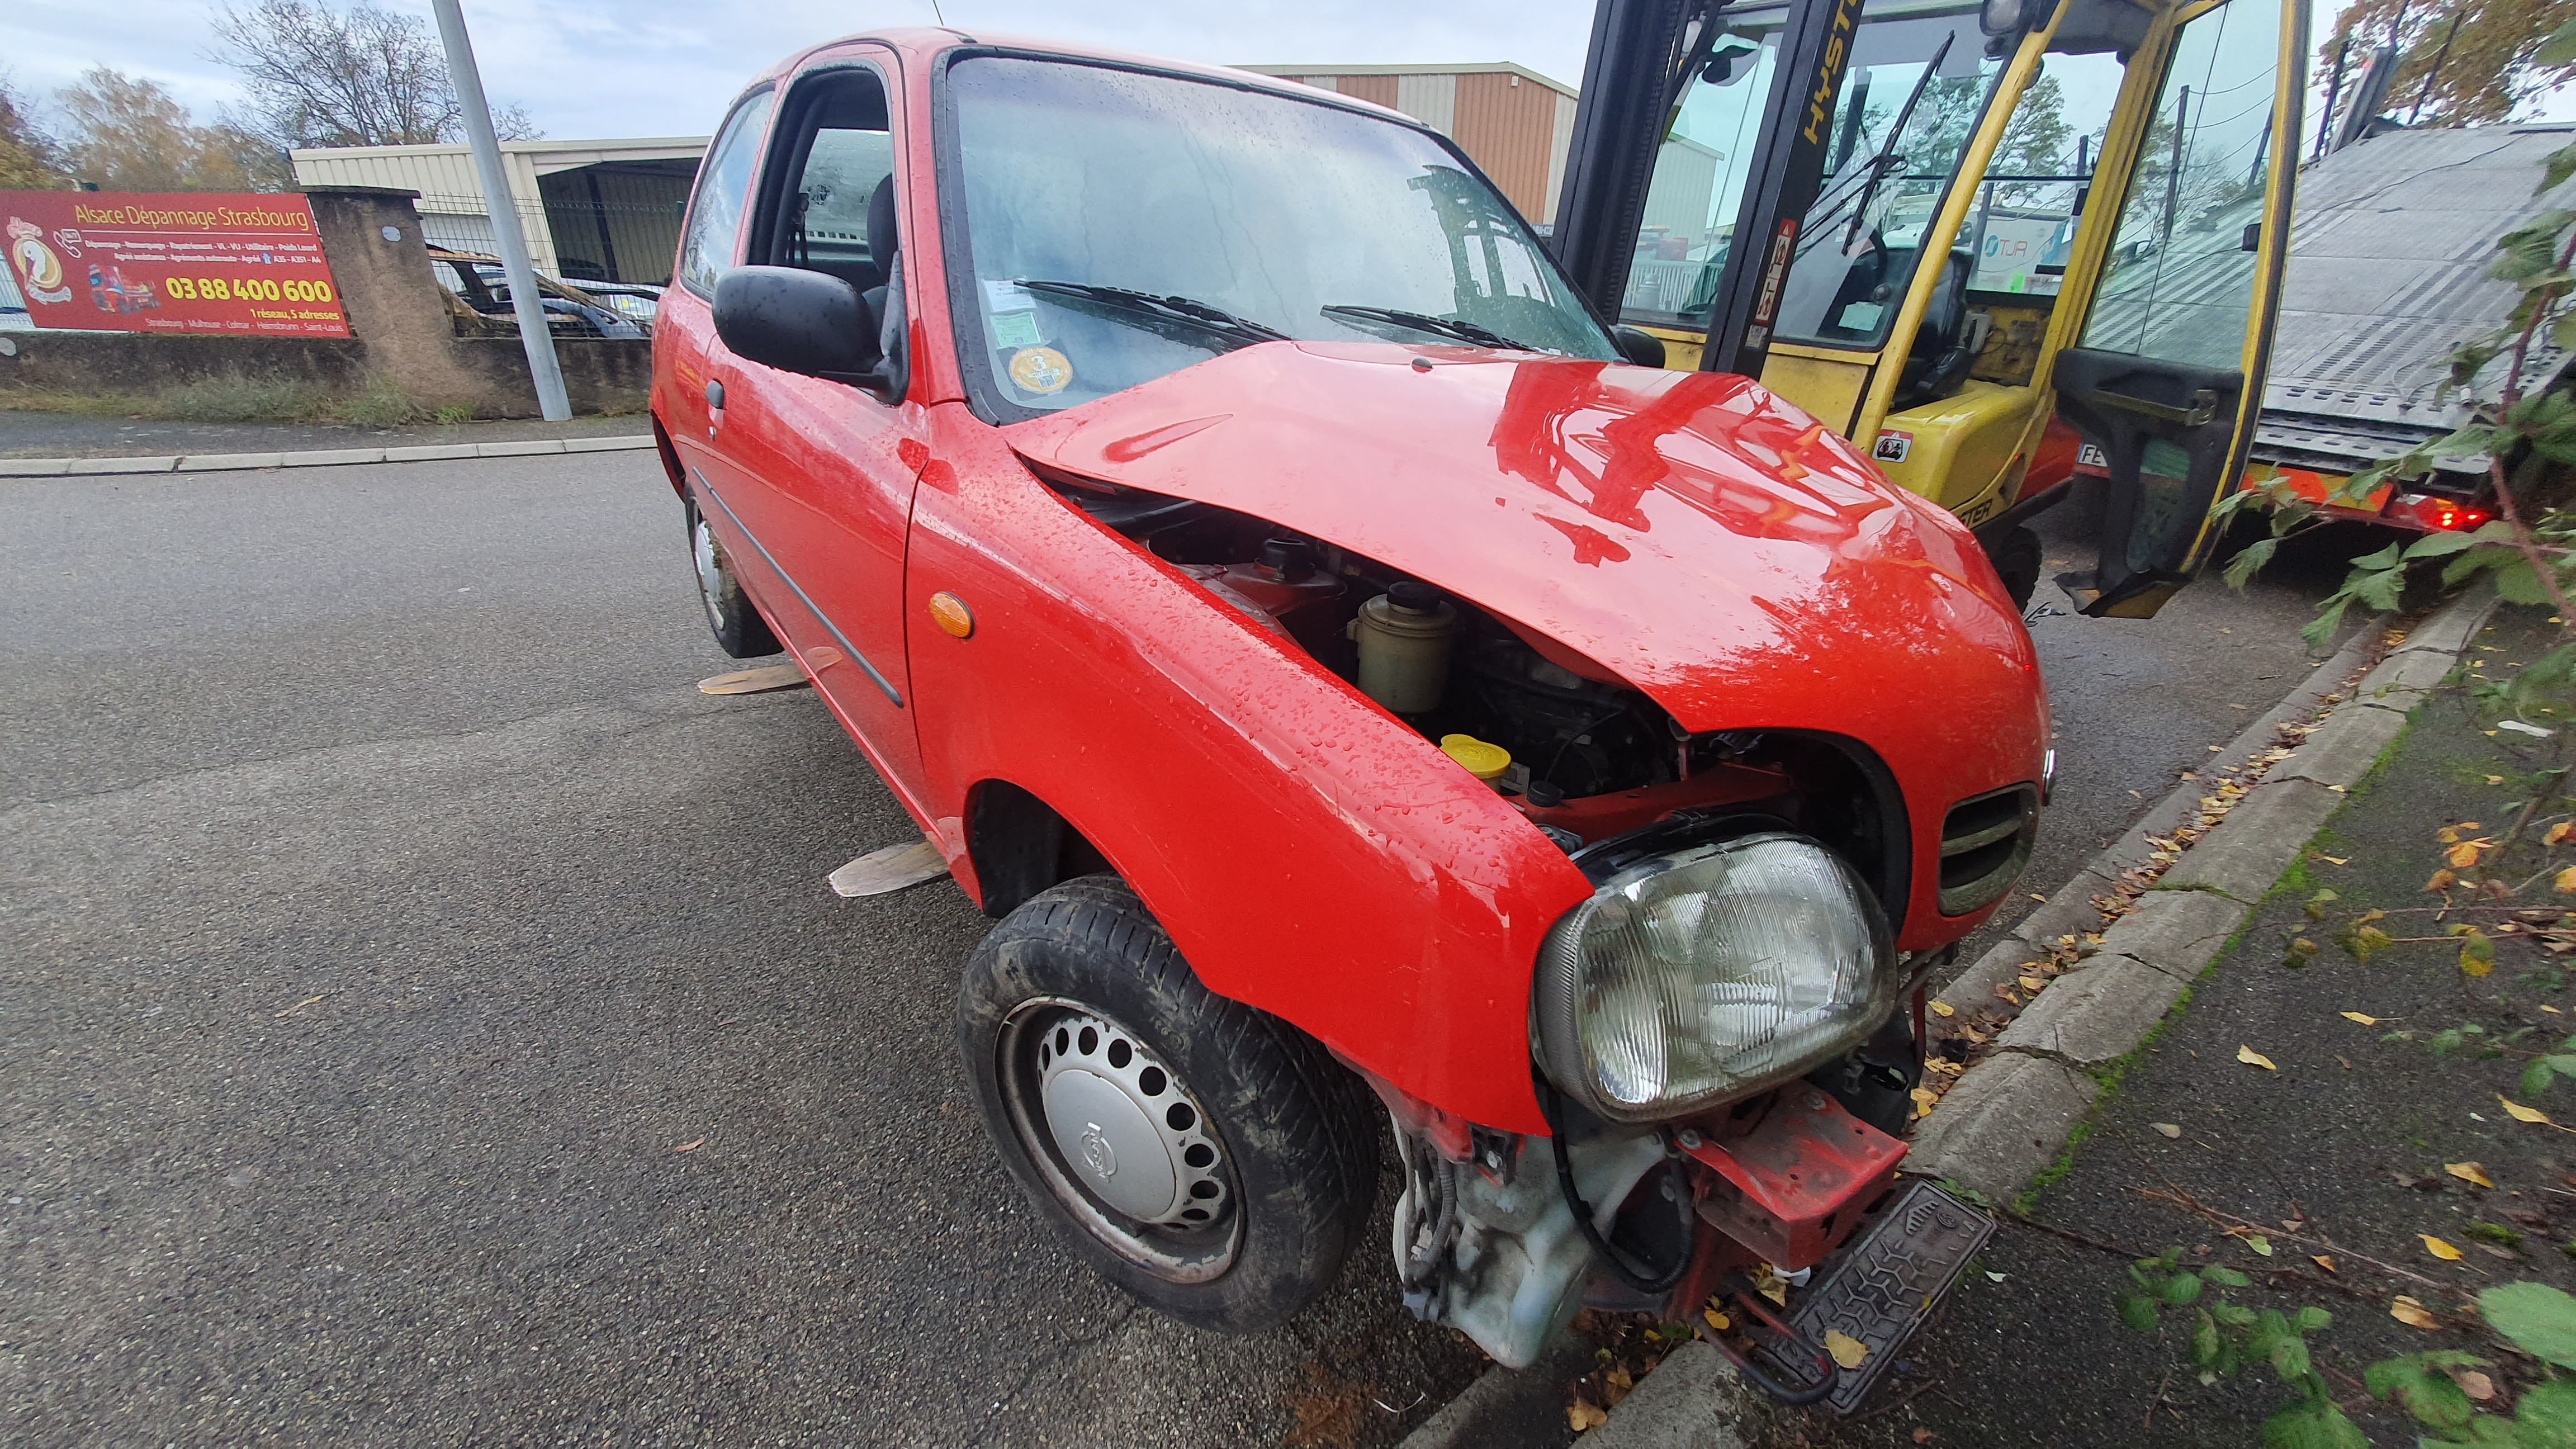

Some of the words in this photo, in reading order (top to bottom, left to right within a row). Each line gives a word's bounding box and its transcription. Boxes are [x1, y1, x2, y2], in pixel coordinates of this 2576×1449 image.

[1804, 0, 1857, 145] HYST
[74, 203, 126, 224] Alsace
[125, 205, 217, 230] Dépannage
[218, 206, 309, 231] Strasbourg
[165, 277, 197, 300] 03
[198, 278, 231, 300] 88
[233, 279, 280, 301] 400
[283, 280, 332, 302] 600
[250, 309, 257, 318] 1
[257, 309, 291, 320] réseau,
[290, 309, 298, 319] 5
[298, 309, 340, 320] adresses
[304, 323, 344, 332] Saint-Louis
[1031, 355, 1047, 371] 3
[1958, 498, 1993, 528] STER
